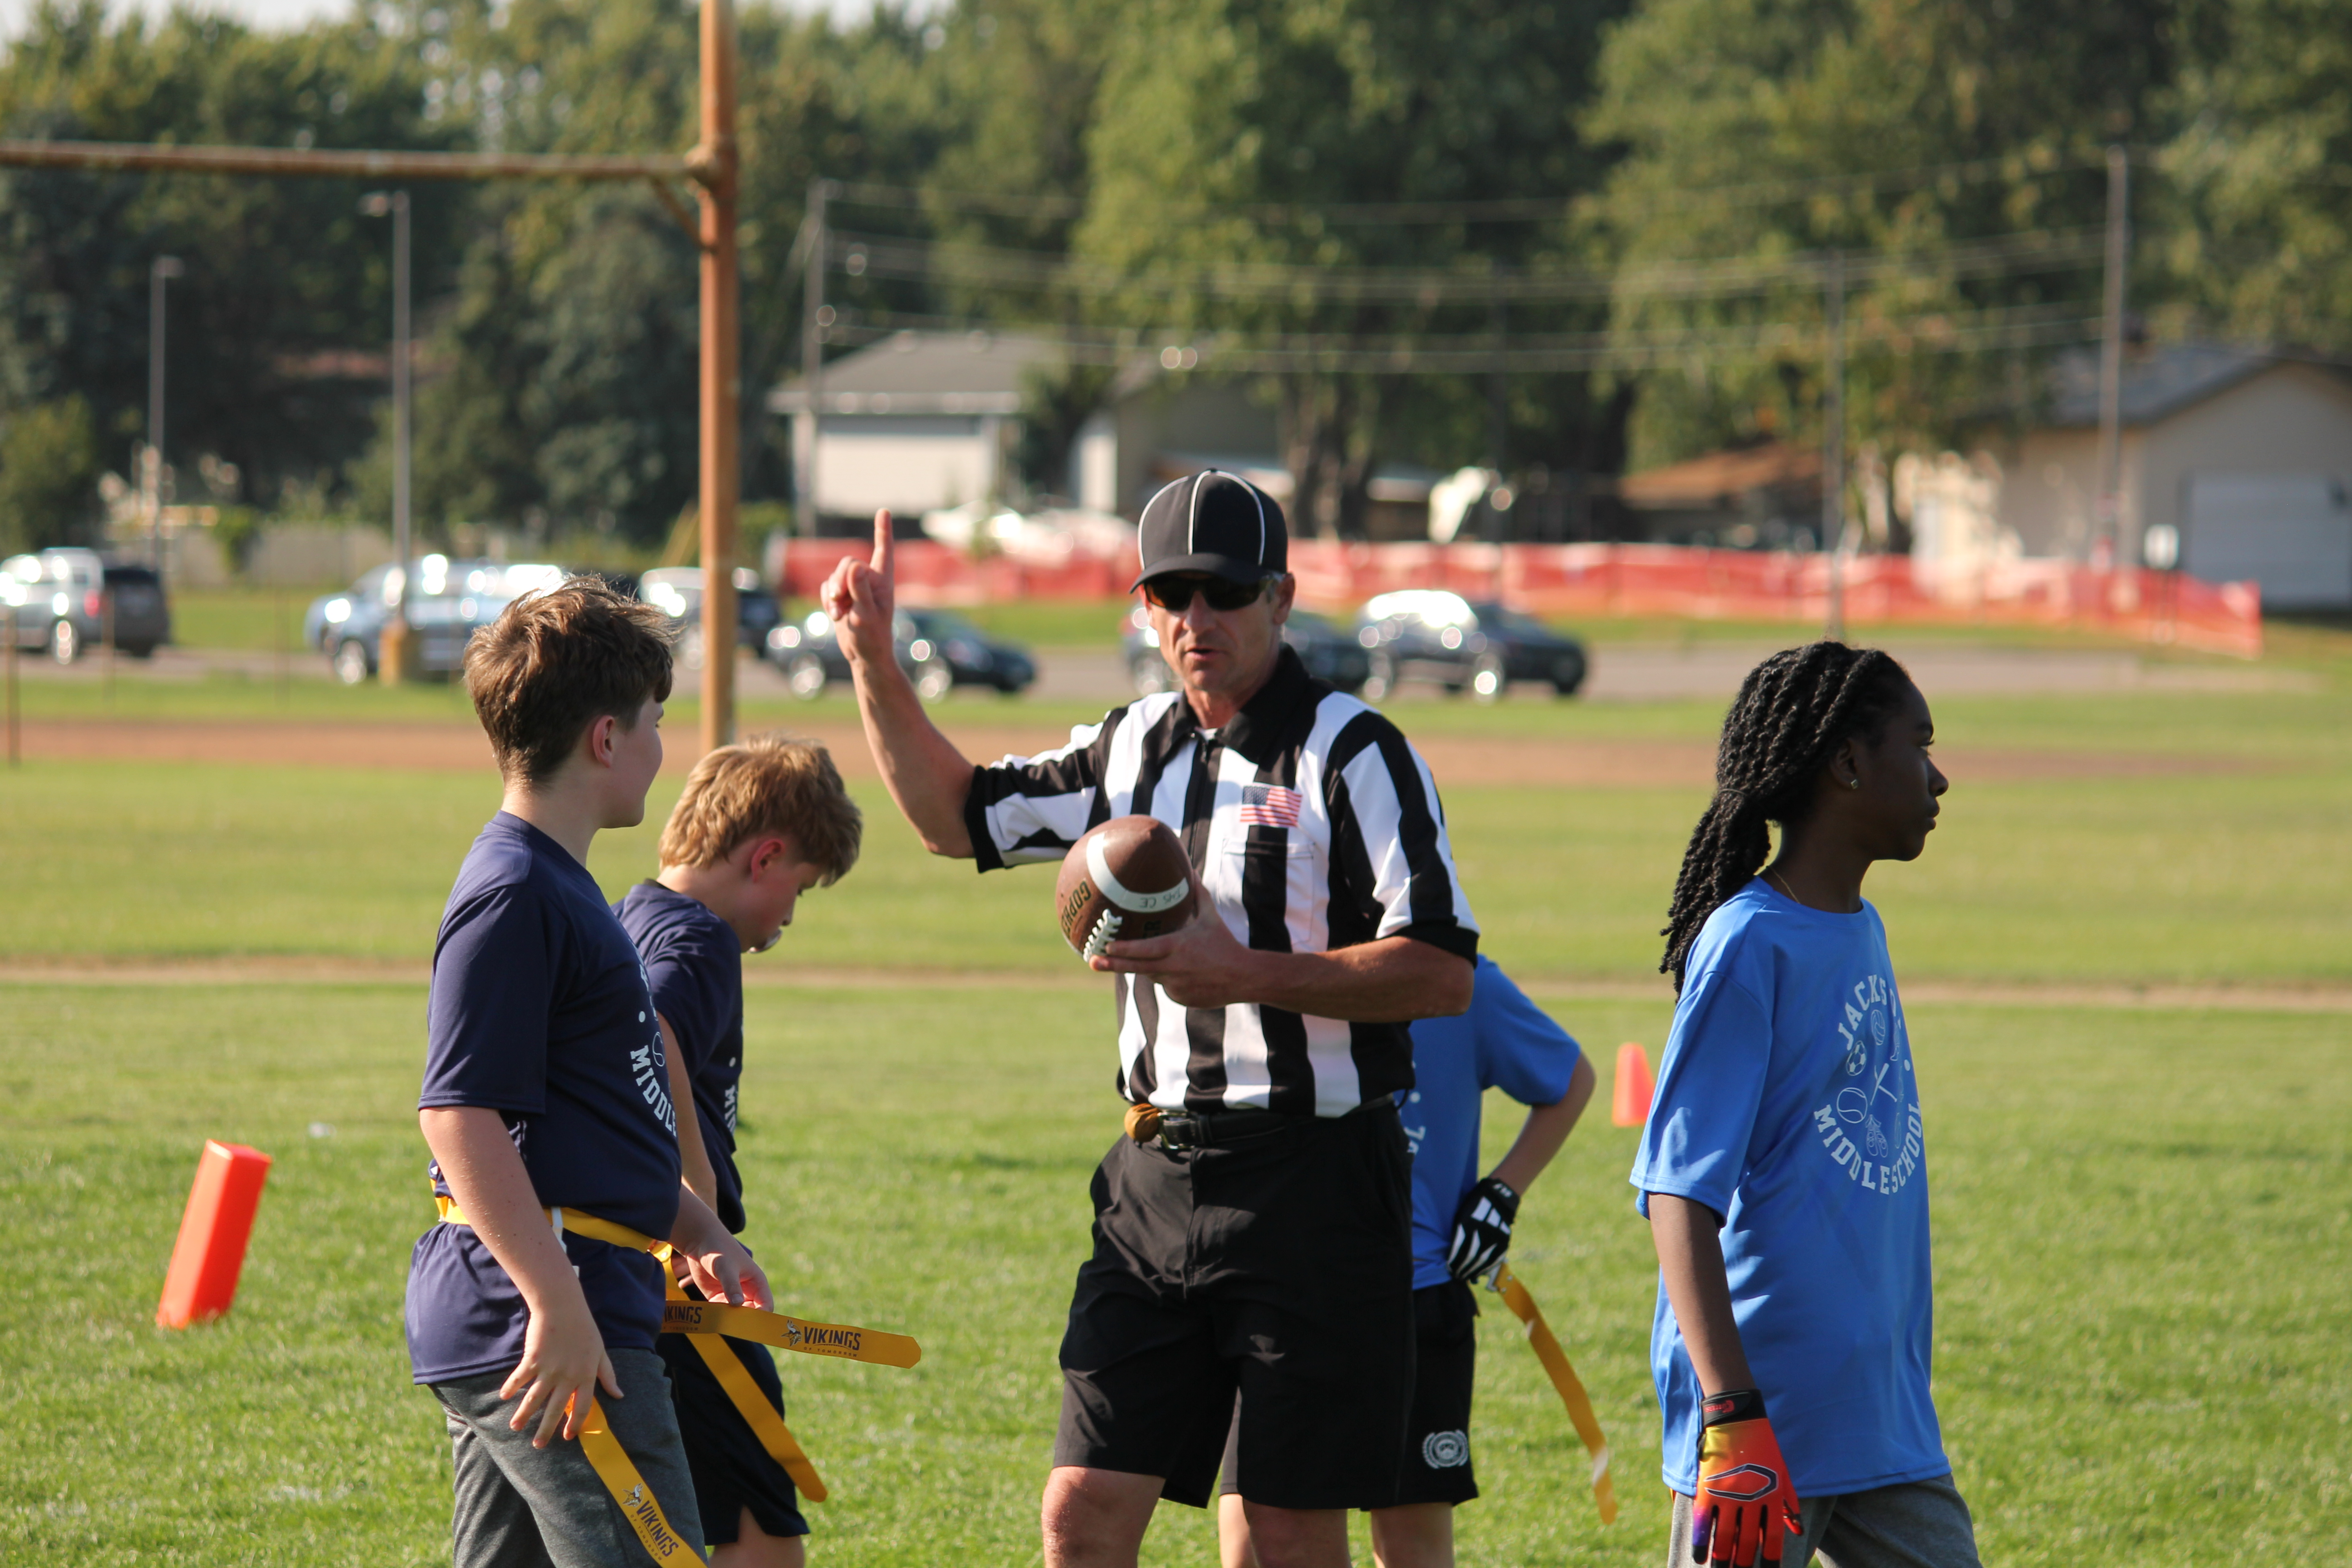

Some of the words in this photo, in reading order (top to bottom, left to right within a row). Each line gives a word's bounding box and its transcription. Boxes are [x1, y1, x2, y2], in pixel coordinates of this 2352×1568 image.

[1838, 974, 1901, 1051] JACKSO
[664, 1305, 703, 1324] IKINGS
[804, 1326, 862, 1351] VIKINGS
[818, 1348, 858, 1357] TOMORROW
[636, 1500, 679, 1557] VIKINGS
[638, 1526, 662, 1561] TOMORROW
